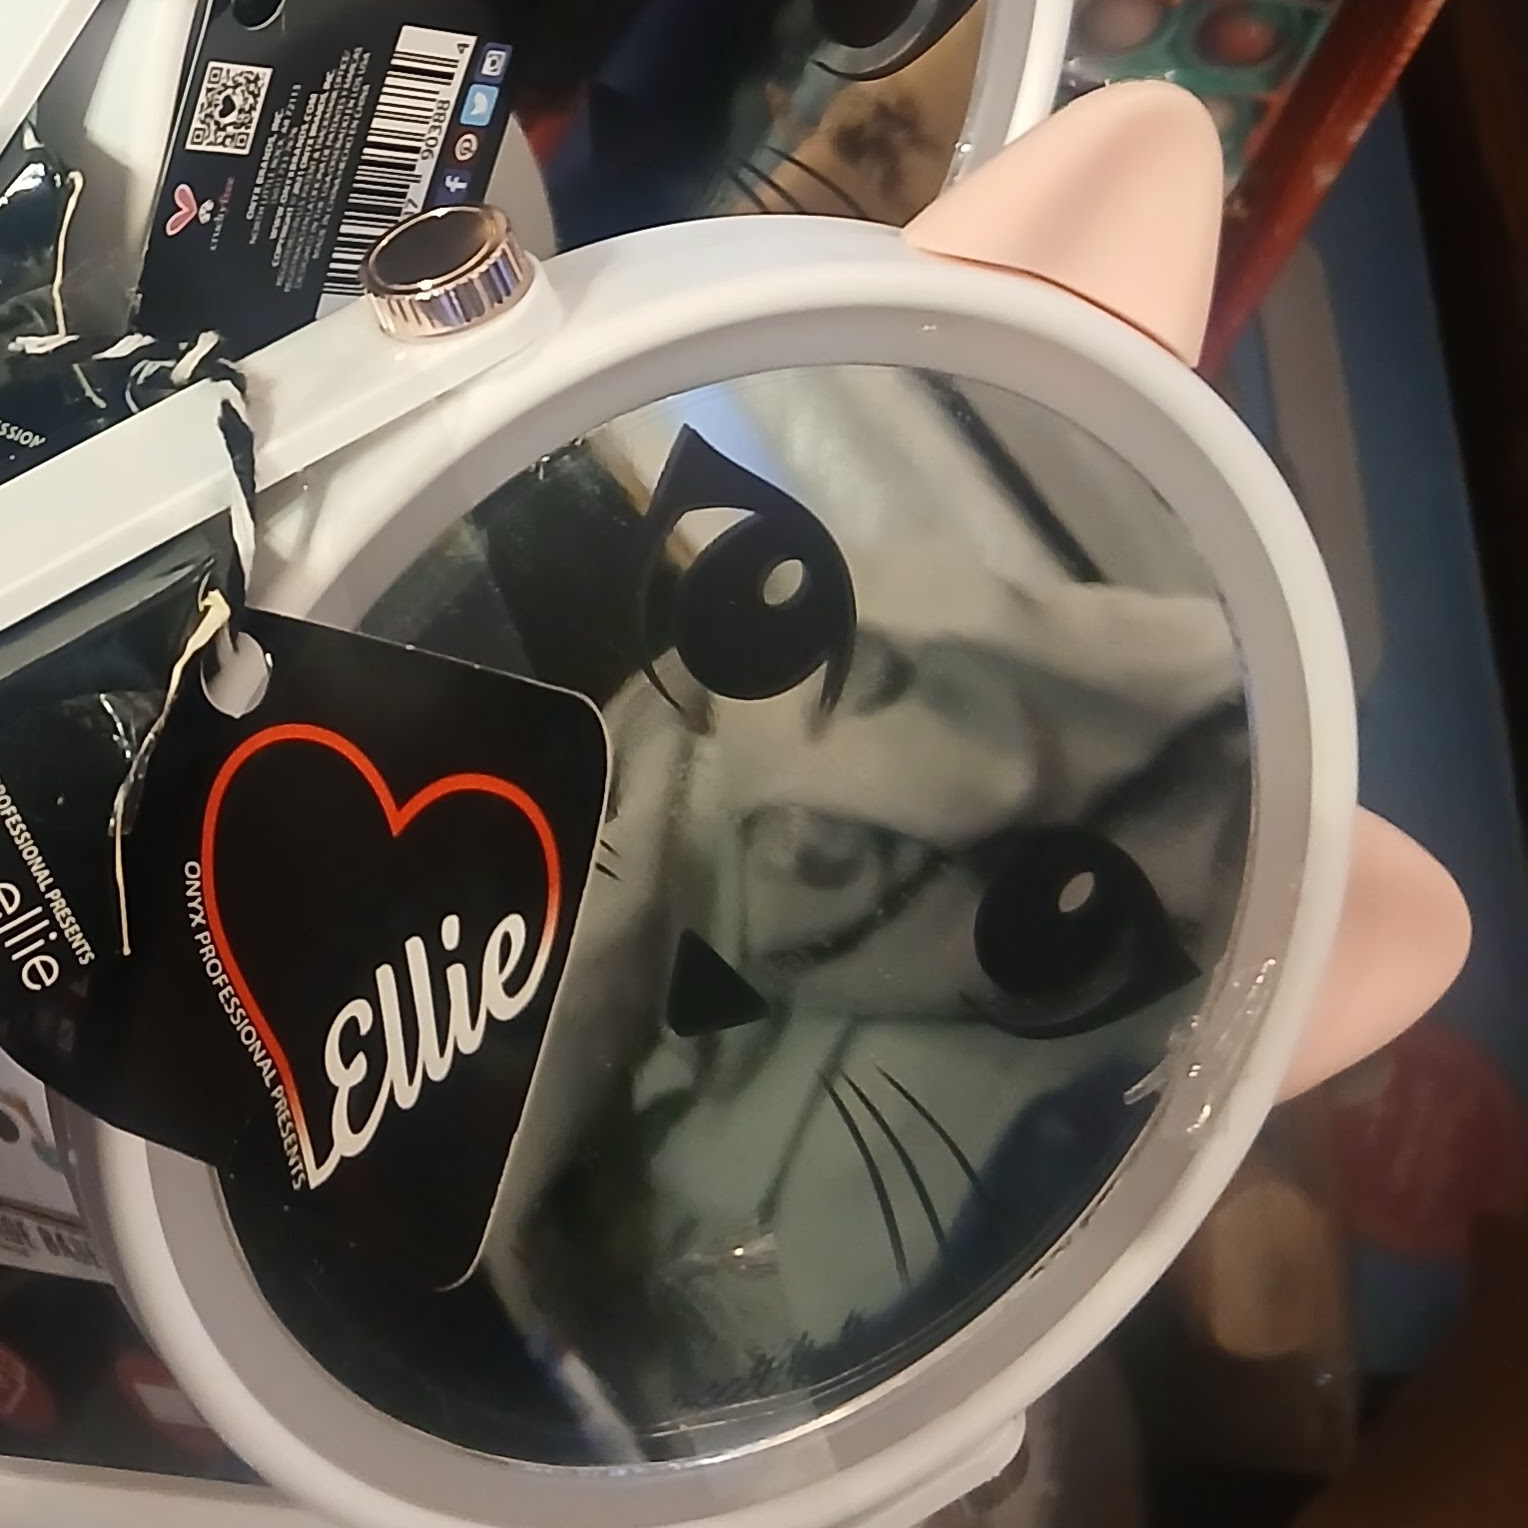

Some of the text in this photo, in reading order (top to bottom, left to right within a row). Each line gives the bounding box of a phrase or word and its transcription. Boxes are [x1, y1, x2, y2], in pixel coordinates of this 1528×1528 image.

[420, 98, 451, 162] 90388
[454, 42, 470, 54] 4
[44, 884, 97, 968] PRESENTS
[182, 859, 306, 1191] ONYX PROFESSIONAL PRESENTS
[310, 912, 528, 1190] Ellie
